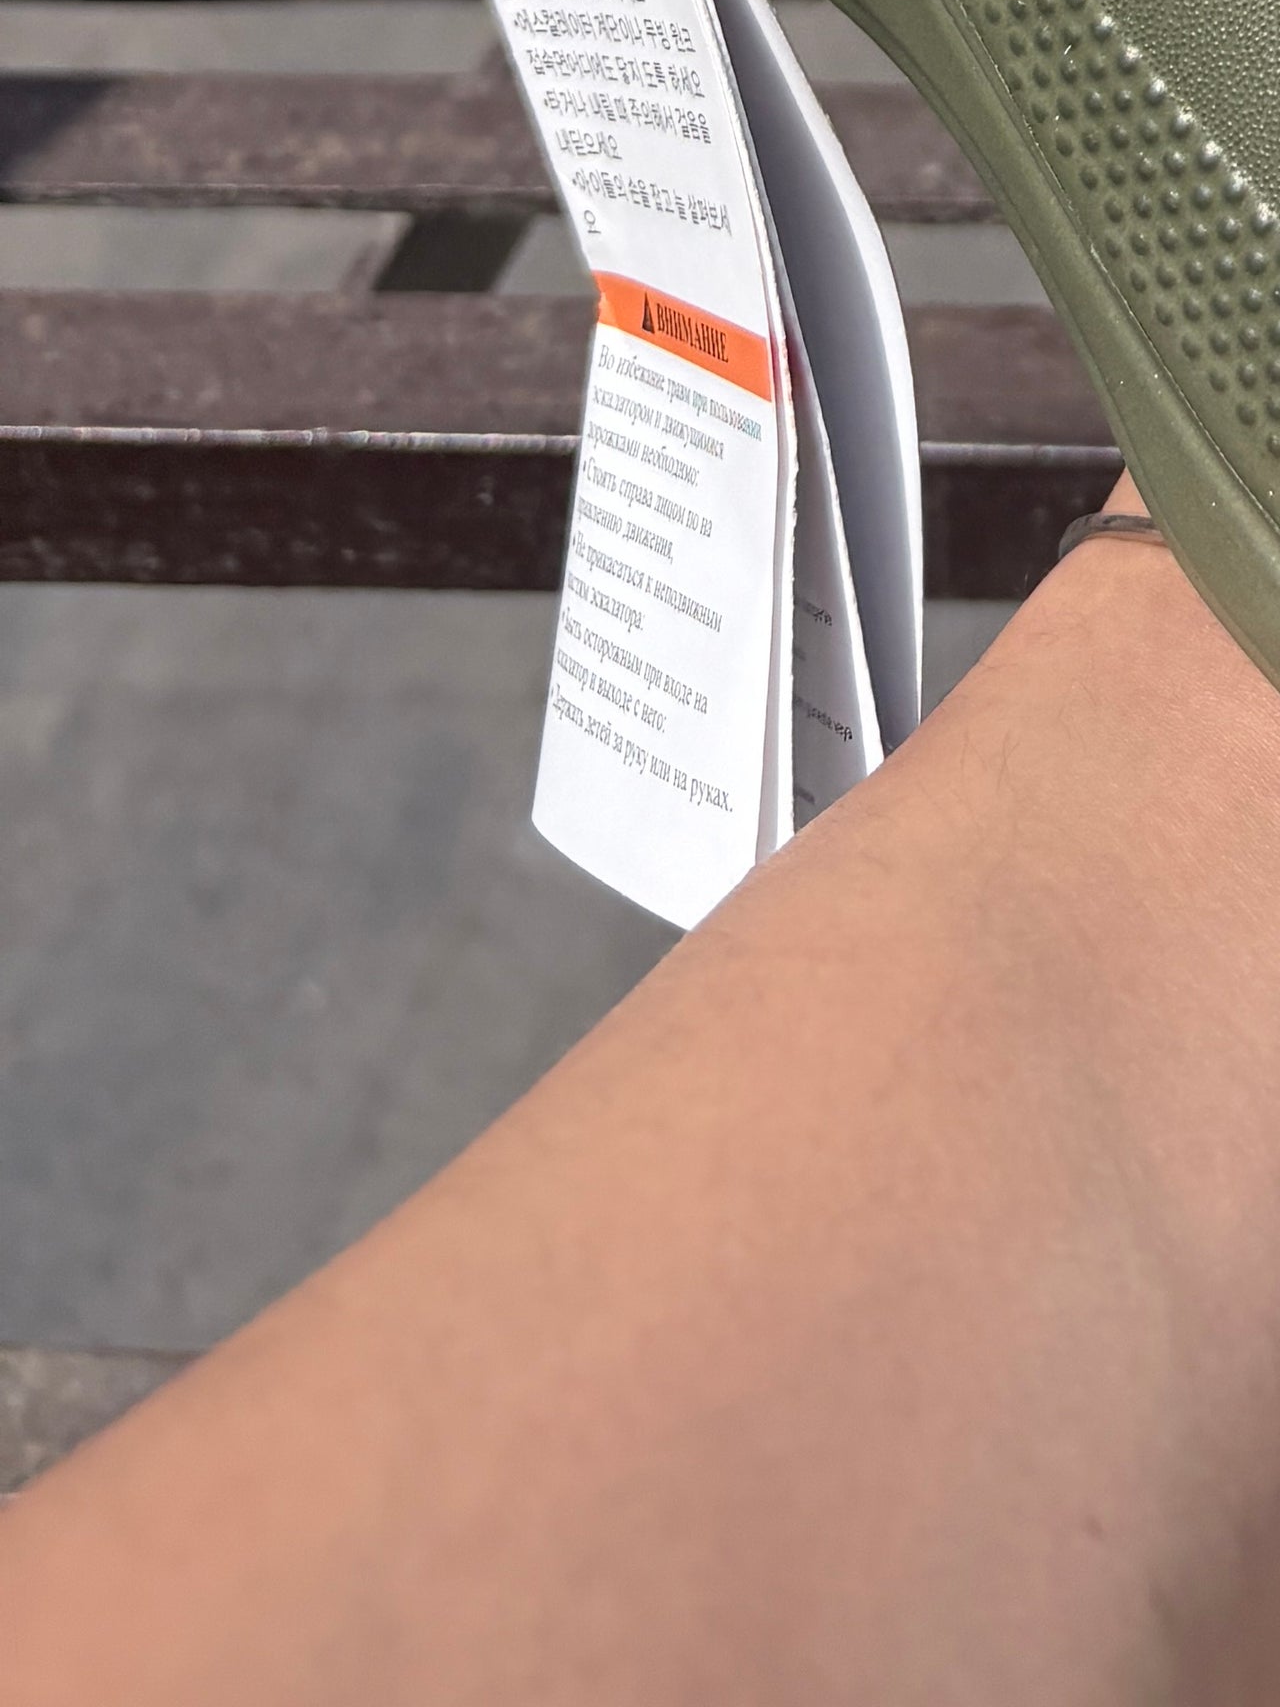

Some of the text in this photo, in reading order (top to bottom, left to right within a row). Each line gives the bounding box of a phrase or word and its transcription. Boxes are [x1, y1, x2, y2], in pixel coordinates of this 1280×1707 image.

[583, 208, 601, 234] 요
[656, 303, 729, 363] ВНИМАНИЕ
[598, 344, 614, 370] Во
[693, 690, 708, 715] на
[649, 755, 672, 783] или
[672, 767, 687, 792] на
[689, 778, 733, 813] руках.
